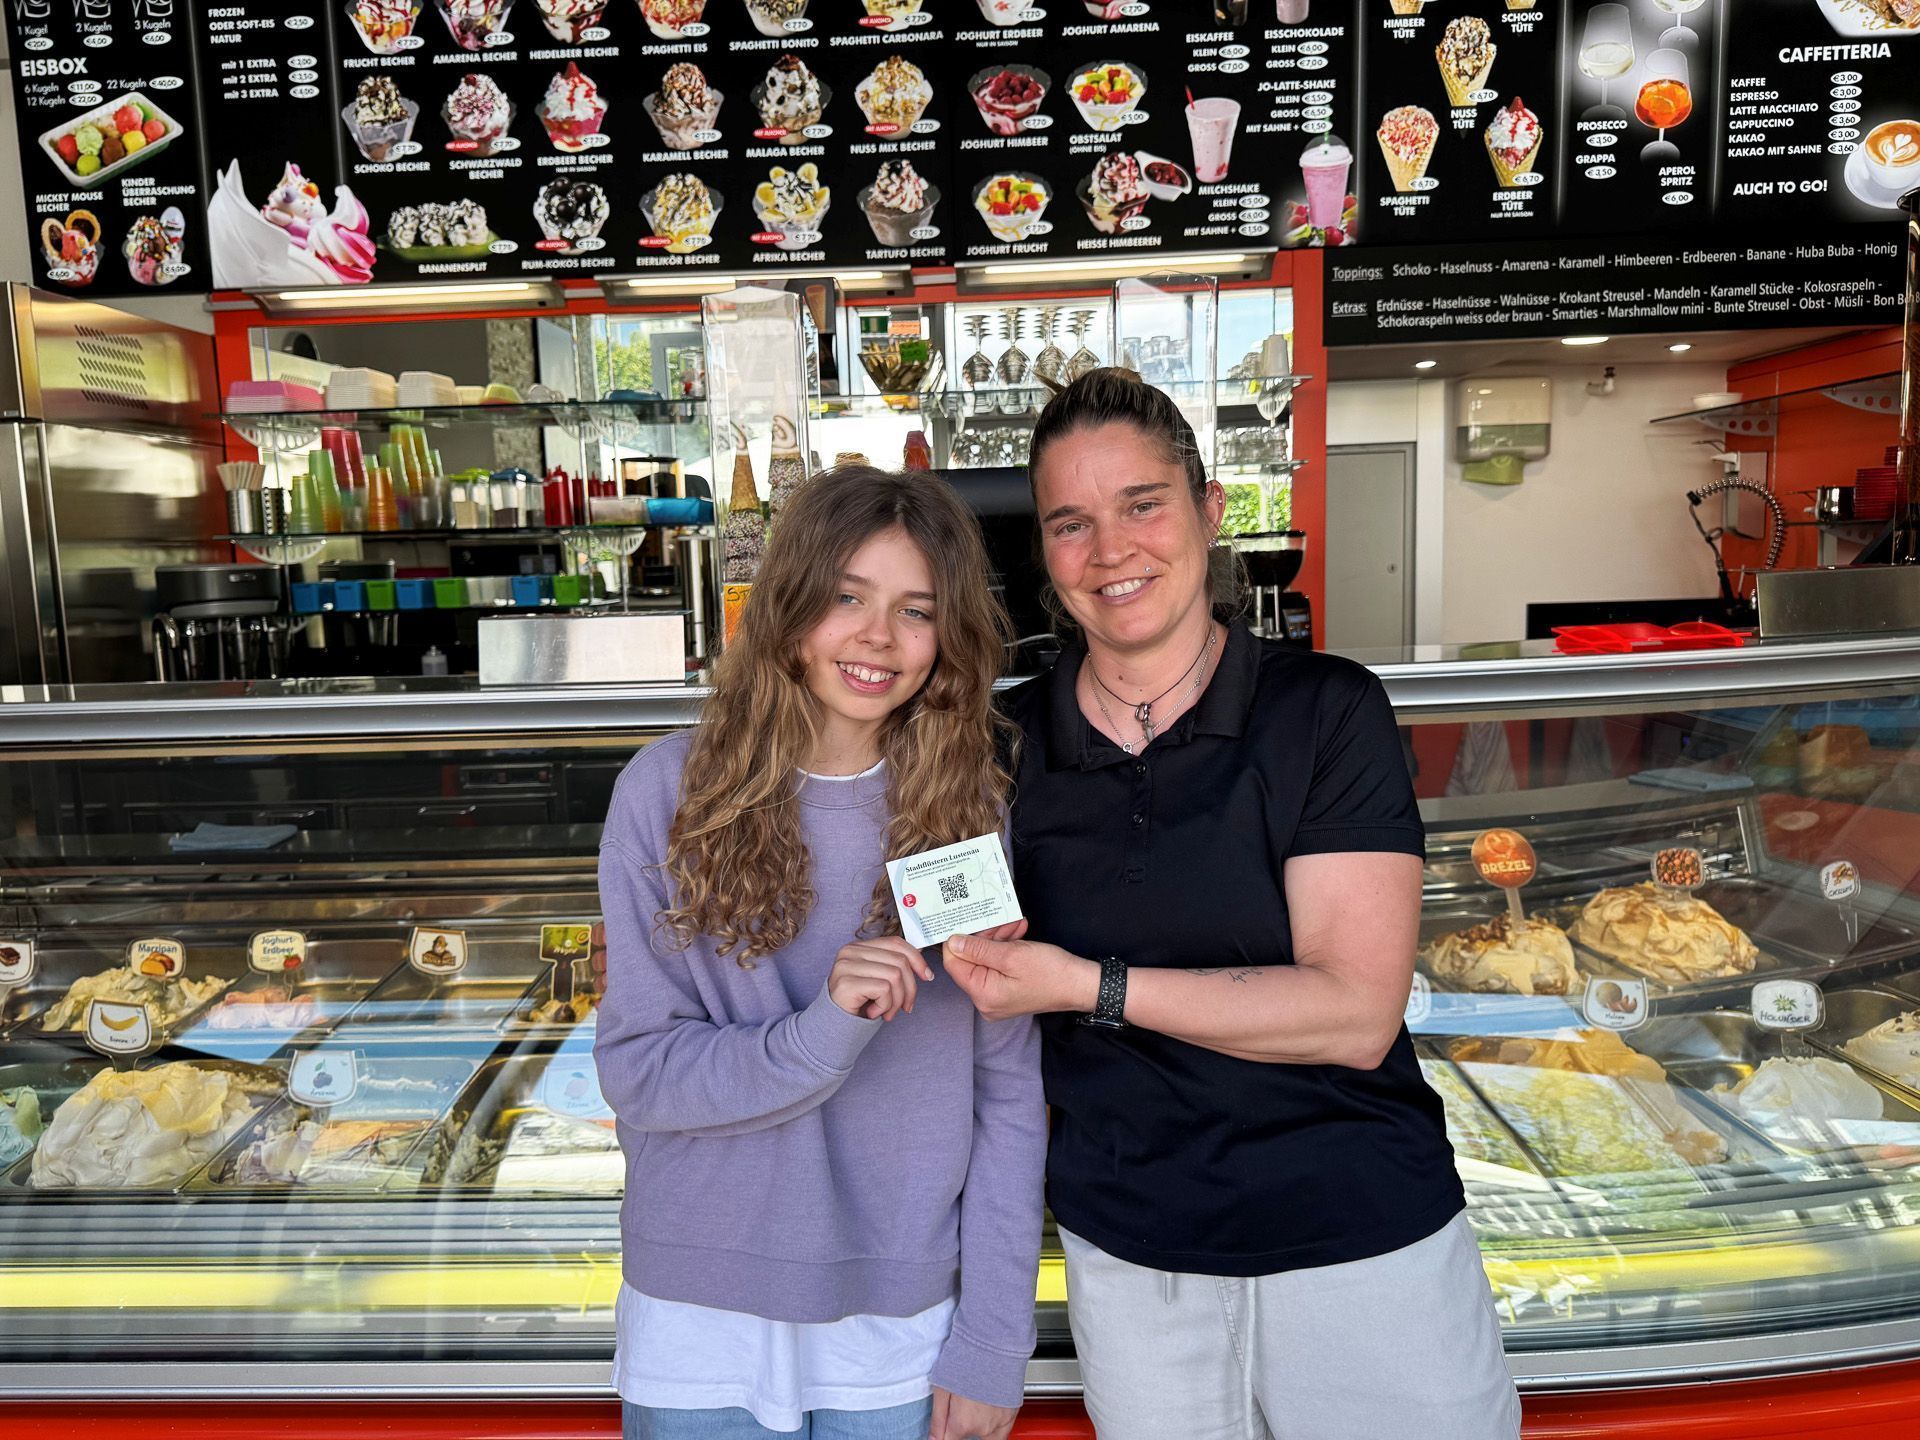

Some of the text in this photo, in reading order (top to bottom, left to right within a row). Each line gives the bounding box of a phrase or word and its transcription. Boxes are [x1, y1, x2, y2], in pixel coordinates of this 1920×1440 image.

[1384, 18, 1425, 29] HIMBEER
[1502, 12, 1543, 23] SCHOKO
[25, 24, 48, 37] Kugel
[76, 22, 112, 34] 2 Kugeln
[135, 20, 171, 33] 3 Kugeln
[1062, 22, 1160, 36] JOGHURT AMARENA
[1511, 23, 1534, 33] TÜTE
[830, 30, 944, 47] SPAGHETTI CARBONARA
[955, 28, 1043, 41] JOGHURT ERDBEER
[1186, 32, 1234, 43] EISKAFFEE
[1265, 27, 1345, 39] EISSCHOKOLADE
[1393, 28, 1416, 39] TÜTE
[642, 42, 708, 56] SPAGHETTI EIS
[729, 38, 819, 51] SPAGHETTI BONITO
[1271, 45, 1296, 54] KLEIN
[433, 52, 518, 65] AMARENA BECHER
[530, 47, 619, 60] HEIDELBEER BECHER
[1193, 49, 1217, 57] KLEIN
[1779, 43, 1891, 63] CAFFETTERIA
[20, 57, 88, 77] EISBOX
[344, 56, 415, 69] FRUCHT BECHER
[1188, 63, 1217, 73] GROSS
[1266, 60, 1295, 69] GROSS
[24, 82, 59, 95] 6 Kugeln
[107, 78, 147, 91] 22 Kugeln
[1258, 79, 1336, 92] JO-LATTE-SHAKE
[1731, 78, 1766, 87] KAFFEE
[27, 95, 66, 108] 12 Kugeln
[1276, 95, 1300, 104] KLEIN
[1730, 91, 1779, 102] ESPRESSO
[1271, 109, 1300, 118] GROSS
[1451, 109, 1477, 119] NUSS
[1730, 106, 1757, 116] LATTE
[1759, 103, 1819, 114] MACCHIATO
[1246, 123, 1292, 133] MIT SAHNE
[1453, 119, 1475, 129] TÜTE
[1577, 120, 1628, 131] PROSECCO
[1729, 118, 1794, 130] CAPPUCCINO
[960, 137, 1049, 150] JOGHURT HIMBEER
[1069, 133, 1123, 145] OBSTSALAT
[1729, 134, 1765, 143] KAKAO
[746, 145, 825, 159] MALAGA BECHER
[850, 140, 936, 154] NUSS MIX BECHER
[1728, 147, 1765, 157] KAKAO
[1767, 146, 1785, 156] MIT
[1787, 145, 1822, 154] SAHNE
[537, 154, 613, 166] ERDBEER BECHER
[643, 149, 729, 163] KARAMELL BECHER
[1576, 154, 1616, 164] GRAPPA
[354, 162, 431, 174] SCHOKO BECHER
[450, 158, 522, 170] SCHWARZWALD
[469, 169, 504, 180] BECHER
[1659, 166, 1696, 176] APEROL
[121, 178, 155, 187] KINDER
[1660, 177, 1693, 187] SPRITZ
[1733, 180, 1828, 196] AUCH TO GO!
[122, 185, 196, 197] ÜBERRASCHUNG
[1198, 183, 1260, 195] MILCHSHAKE
[36, 192, 103, 203] MICKEY MOUSE
[123, 197, 156, 207] BECHER
[1380, 196, 1430, 207] SPAGHETTI
[1493, 191, 1533, 201] ERDBEER
[37, 203, 70, 213] BECHER
[1393, 206, 1416, 216] TÜTE
[1501, 201, 1524, 211] TÜTE
[1077, 236, 1162, 250] HEISSE HIMBEEREN
[865, 247, 946, 260] TARTUFO BECHER
[966, 243, 1048, 256] JOGHURT FRUCHT
[636, 254, 720, 267] EIERLIKÖR BECHER
[753, 251, 825, 263] AFRIKA BECHER
[1332, 242, 1898, 280] Toppings: Schoko Haselnuss Amarena Karamell Himbeeren Erdbeeren Banane Huba Buba Honig
[418, 262, 487, 274] BANANENSPLIT
[522, 258, 615, 270] RUM-KOKOS BECHER
[1332, 278, 1876, 315] Extras: Erdnüsse Haselnüsse Walnüsse Krokant Streusel Mandeln Karamell Stücke Kokosraspeln
[1377, 313, 1453, 329] Schokoraspeln
[1455, 313, 1484, 325] weiss
[1485, 311, 1510, 323] oder
[1512, 310, 1543, 322] braun
[1552, 308, 1598, 320] Smarties
[1607, 304, 1679, 319] Marshmallow
[1680, 302, 1705, 316] mini
[1714, 301, 1746, 314] Bunte
[1747, 298, 1790, 312] Streusel
[1799, 296, 1825, 310] Obst
[1834, 295, 1864, 308] Müsli
[1874, 294, 1895, 306] Bon
[948, 848, 980, 861] Lustenau
[1481, 860, 1531, 874] BREZEL
[262, 936, 293, 945] Joghurt
[138, 943, 178, 954] Marzipan
